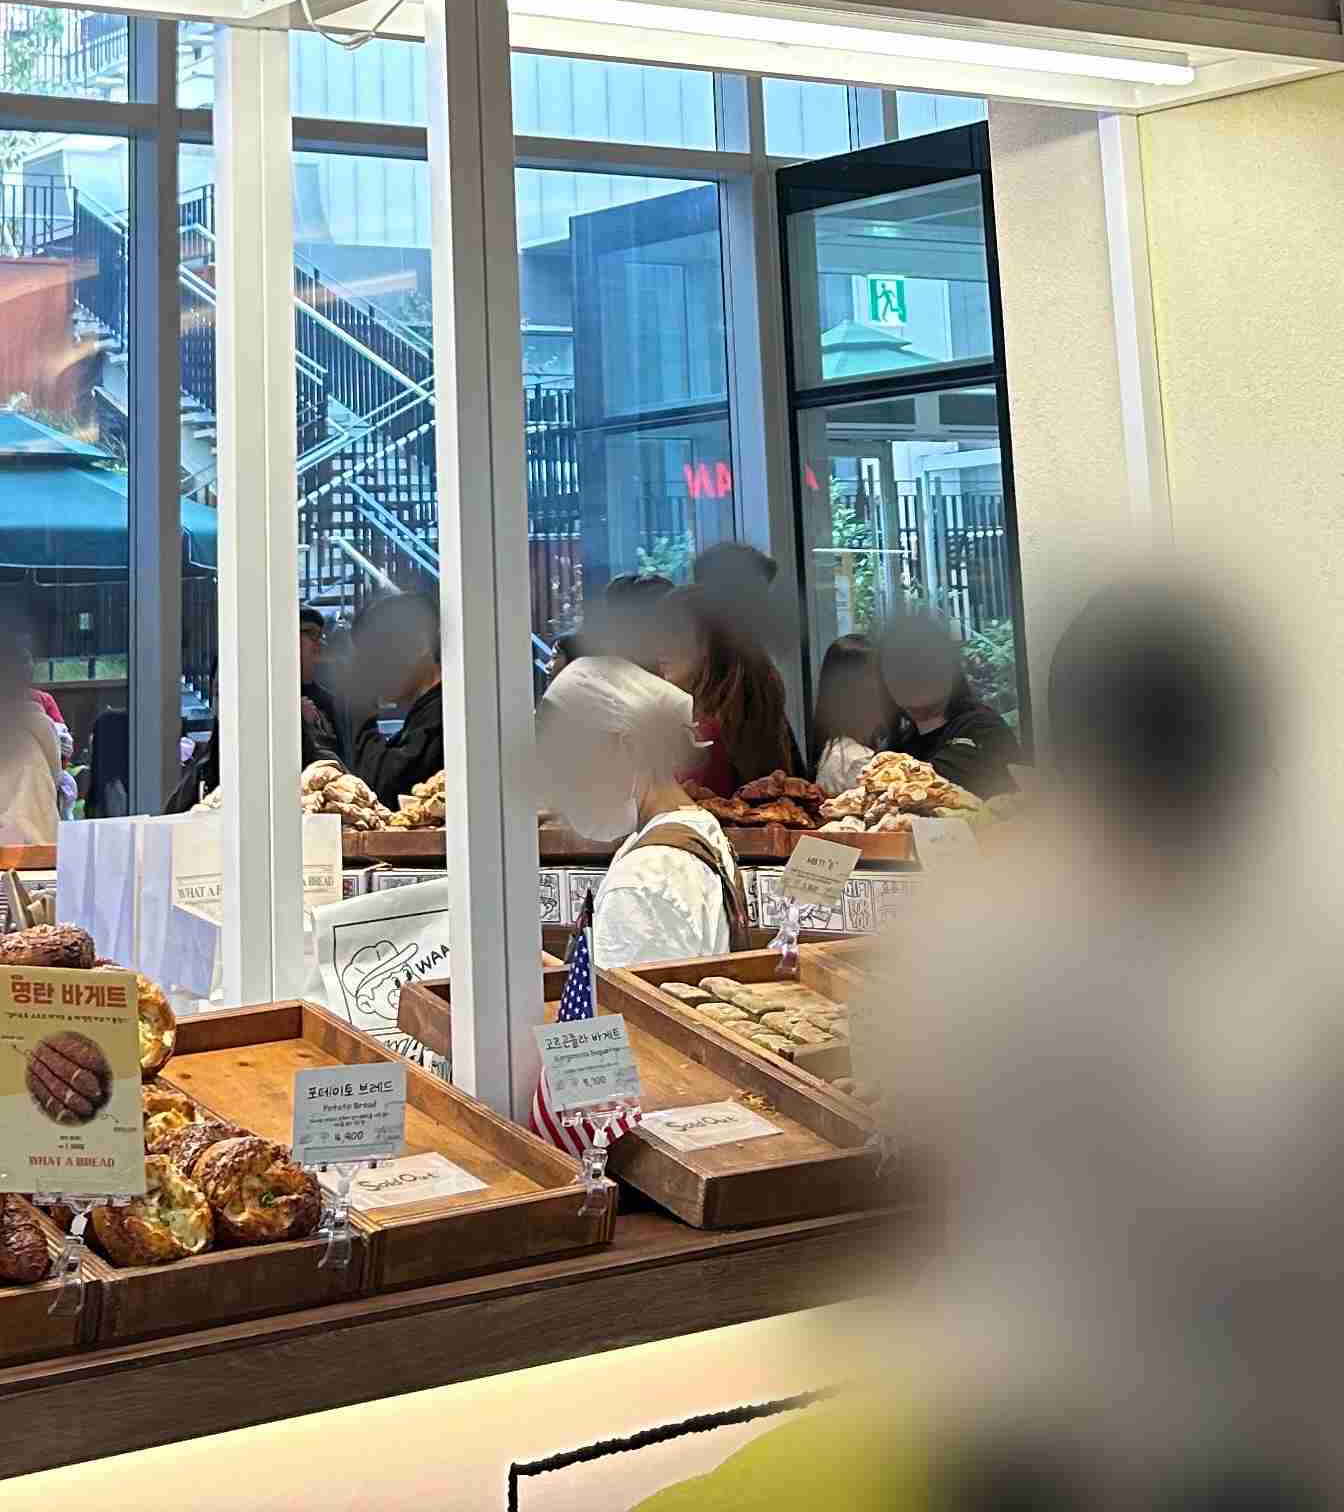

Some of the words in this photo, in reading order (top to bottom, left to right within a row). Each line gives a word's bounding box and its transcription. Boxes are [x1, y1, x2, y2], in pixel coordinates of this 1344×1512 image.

[177, 886, 206, 899] WHAT
[11, 981, 54, 1005] 명란
[61, 983, 128, 1008] 바게트
[590, 1027, 623, 1042] 바게트
[358, 1080, 394, 1096] 브레드
[29, 1155, 61, 1167] WHAT
[65, 1156, 74, 1167] A
